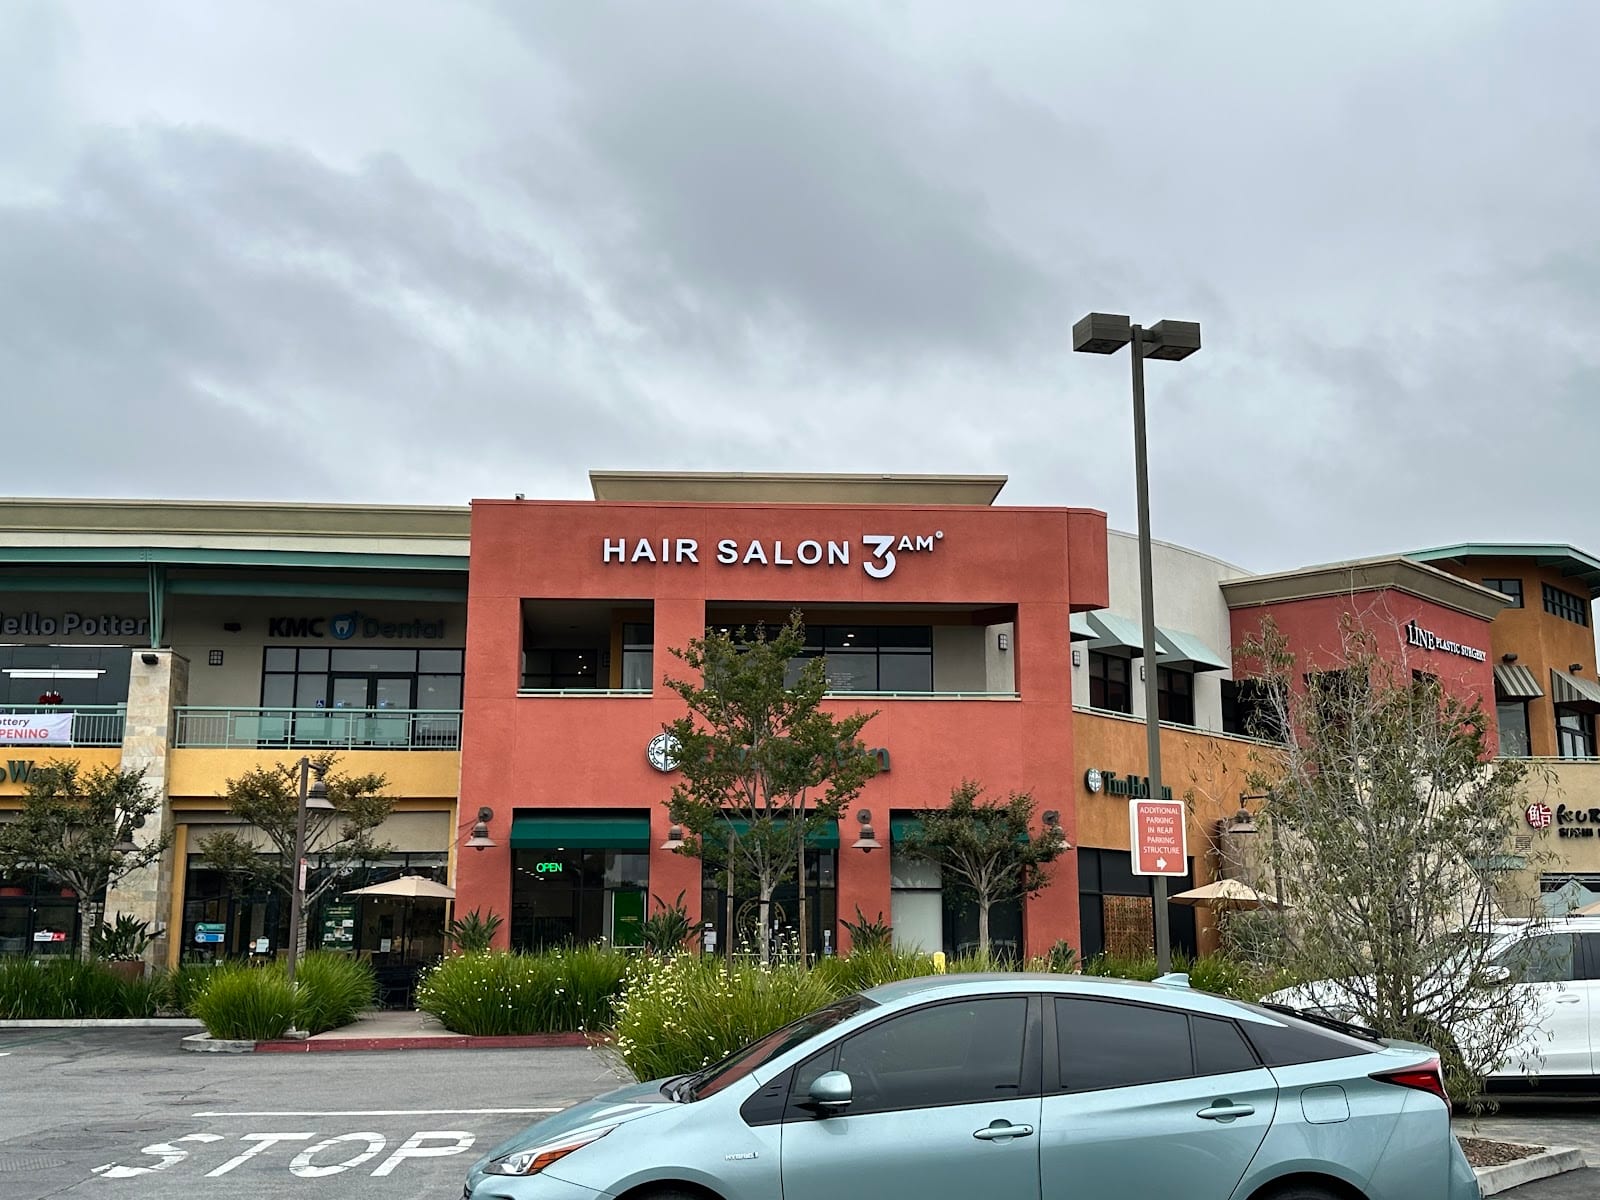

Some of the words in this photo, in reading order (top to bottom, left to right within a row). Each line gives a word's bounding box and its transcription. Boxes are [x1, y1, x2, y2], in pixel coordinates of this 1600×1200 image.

[602, 537, 699, 563] HAIR
[716, 538, 850, 565] SALON
[0, 612, 56, 635] ello
[63, 612, 163, 638] Potter
[268, 616, 325, 638] KMC
[362, 617, 445, 639] Dental
[1407, 624, 1435, 650] LINE
[1435, 637, 1460, 655] PLASTIC
[1460, 645, 1486, 661] SURGERY
[0, 718, 30, 727] ttery
[1140, 806, 1179, 815] ADDITIONAL
[1146, 816, 1174, 825] PARKING
[1156, 826, 1174, 834] REAR
[1147, 836, 1175, 844] PARKING
[1143, 846, 1180, 855] STRUCTURE
[536, 862, 562, 872] OPEN
[91, 1131, 476, 1177] STOP
